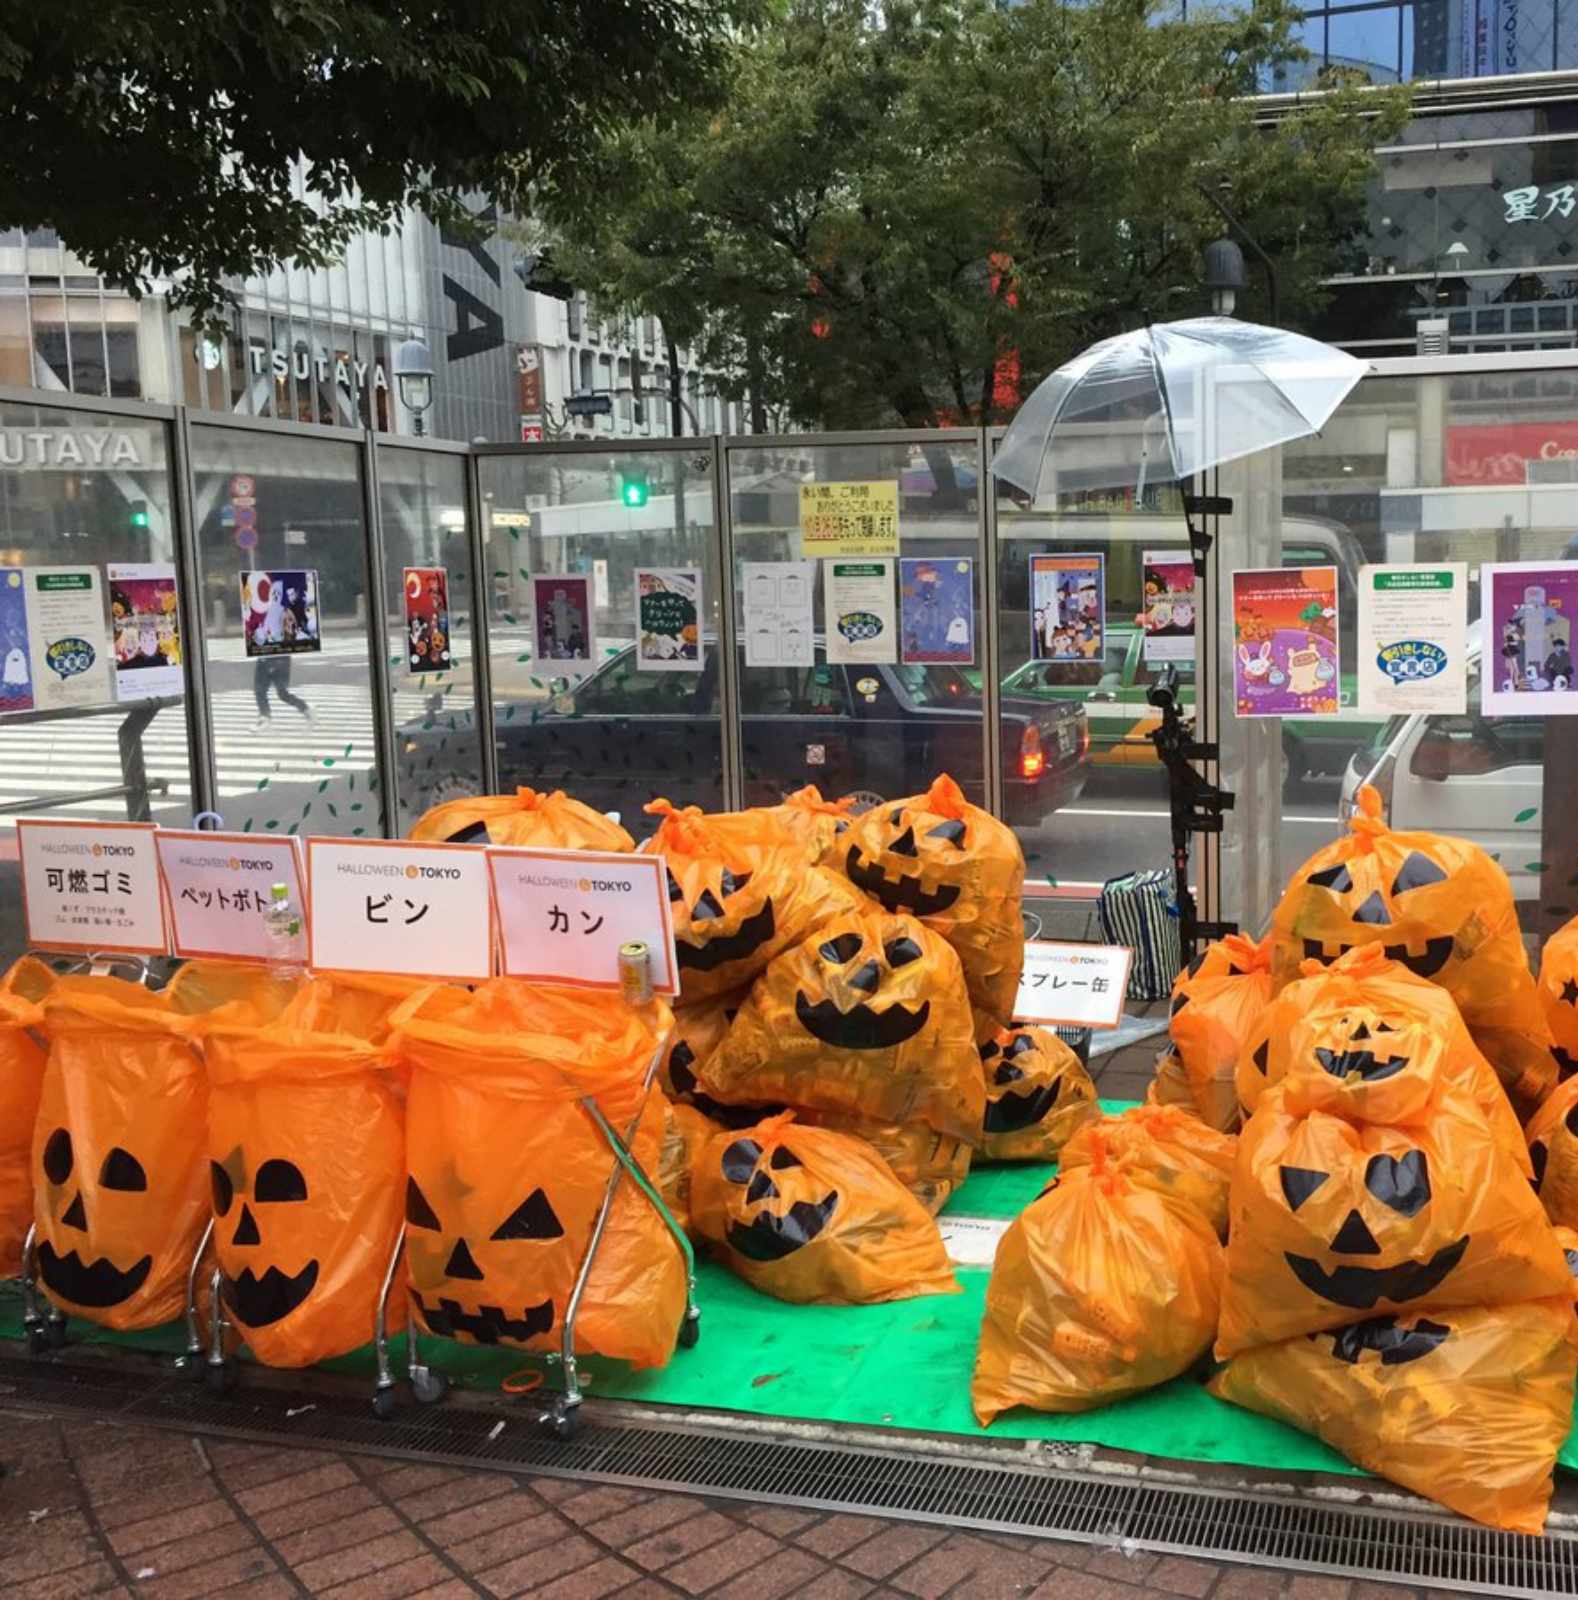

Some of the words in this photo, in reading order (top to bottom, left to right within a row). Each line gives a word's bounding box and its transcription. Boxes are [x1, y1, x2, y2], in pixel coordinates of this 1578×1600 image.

[249, 346, 388, 391] TSUTAYA
[0, 432, 140, 463] UTAYA
[103, 845, 136, 857] TOKYO
[240, 859, 274, 871] TOKYO
[336, 863, 404, 877] HALLOWEEN
[419, 866, 461, 880] TOKYO
[45, 868, 132, 895] 可燃ゴミ
[591, 879, 632, 892] TOKYO
[181, 887, 268, 913] ペットボト
[366, 893, 429, 925] ビン
[547, 904, 604, 935] カン
